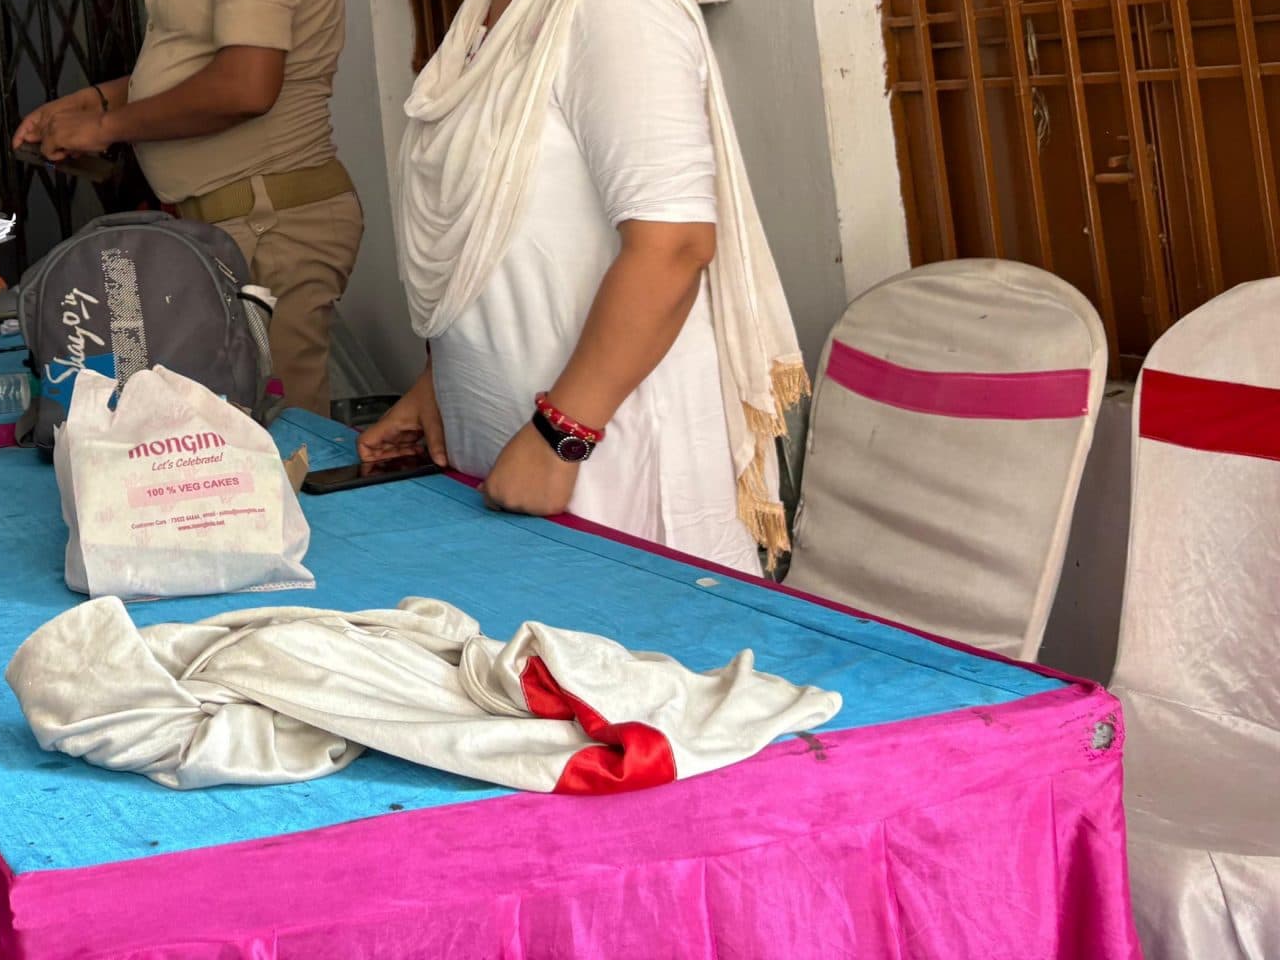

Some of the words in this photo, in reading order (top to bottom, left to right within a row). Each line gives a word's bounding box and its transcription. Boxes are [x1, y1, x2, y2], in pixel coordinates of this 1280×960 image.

[152, 459, 174, 471] Let's
[175, 452, 224, 468] Celebrate!
[146, 487, 164, 497] 100
[166, 485, 176, 495] %
[178, 482, 200, 493] VEG
[203, 477, 240, 489] CAKES
